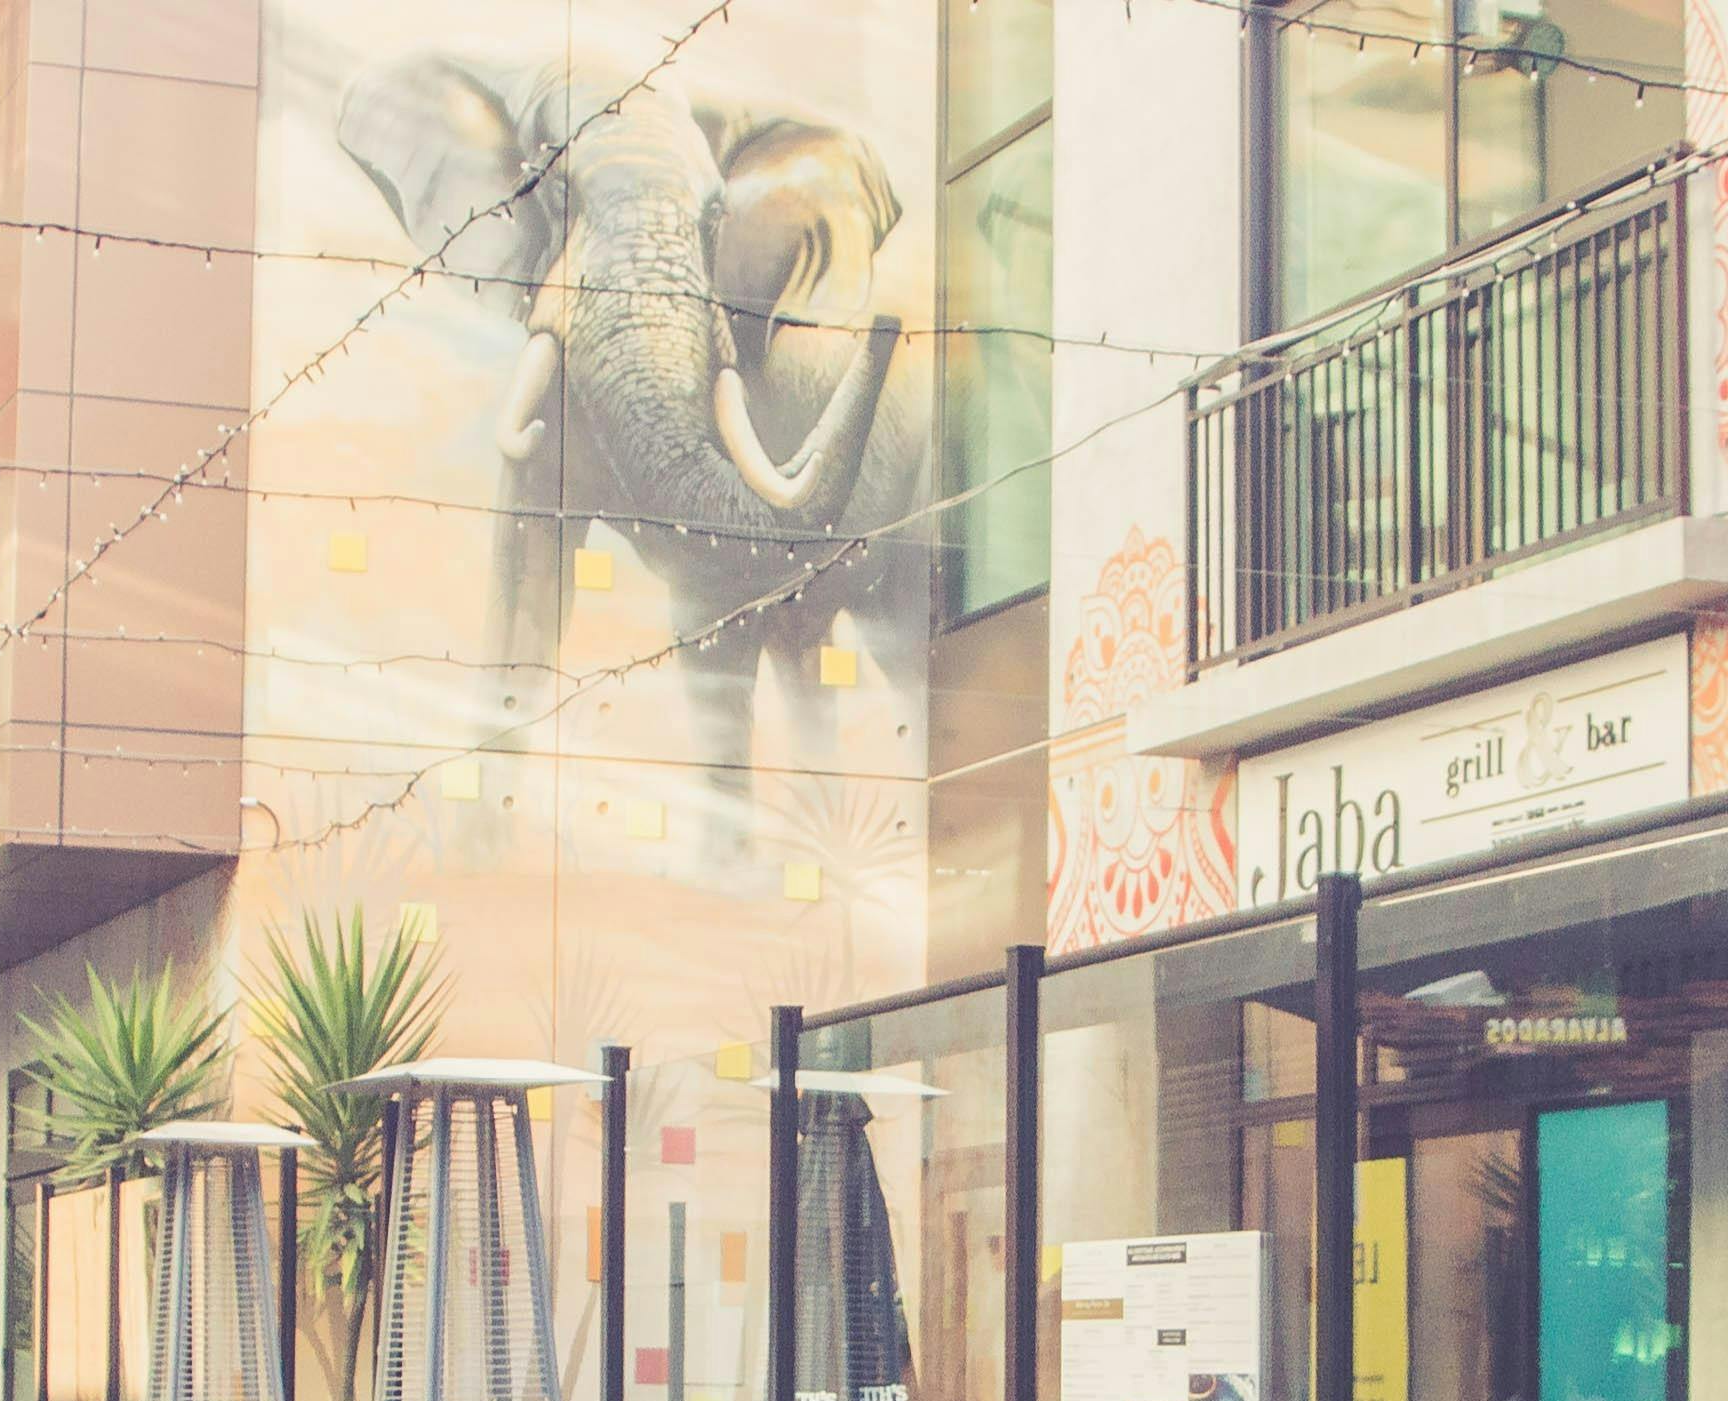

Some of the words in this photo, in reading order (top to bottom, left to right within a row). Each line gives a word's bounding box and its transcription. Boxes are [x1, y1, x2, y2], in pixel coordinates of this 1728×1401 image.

[1446, 735, 1504, 799] grill
[1585, 711, 1632, 752] bar
[1251, 764, 1405, 907] Jaba
